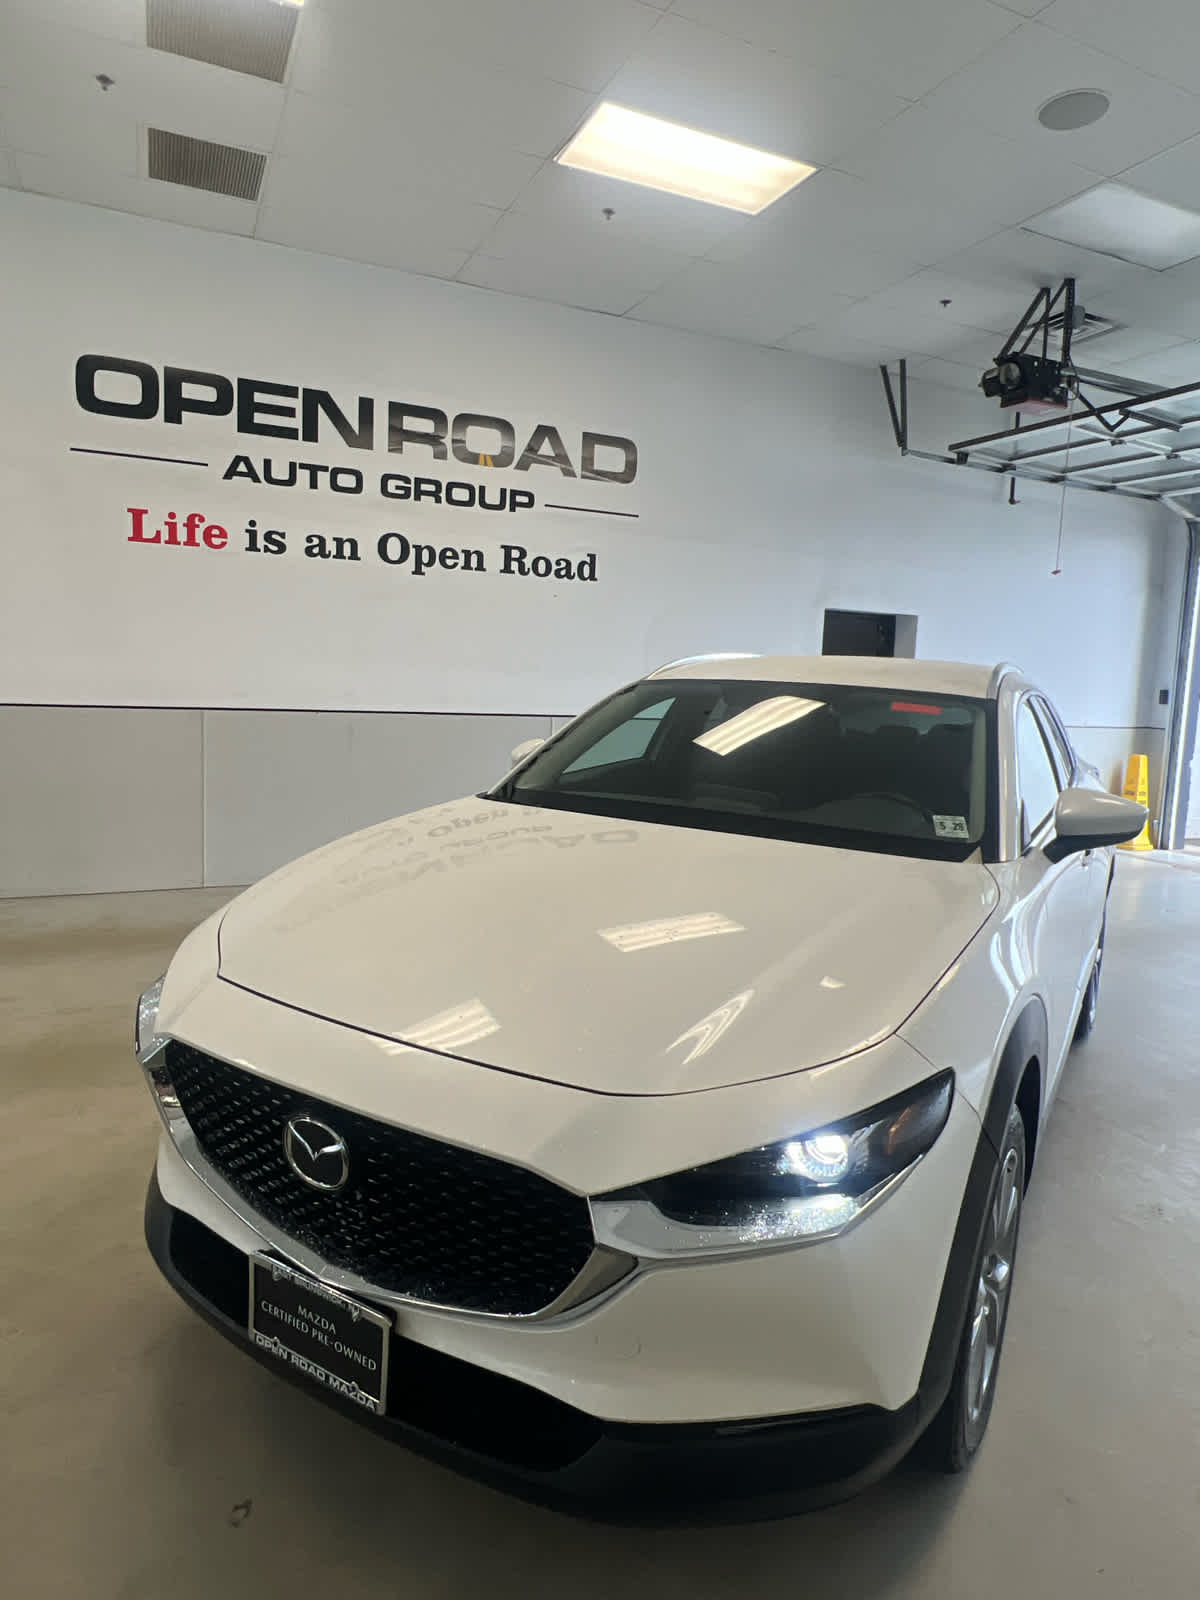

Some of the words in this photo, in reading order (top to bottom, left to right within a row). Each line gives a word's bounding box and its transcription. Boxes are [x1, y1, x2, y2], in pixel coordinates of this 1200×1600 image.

[222, 455, 363, 494] AUTO
[380, 473, 535, 512] GROUP
[127, 508, 228, 550] Life
[245, 520, 286, 555] is
[304, 534, 361, 561] an
[377, 532, 486, 575] Open
[500, 545, 598, 581] Road
[261, 1300, 309, 1334] CERTIFIED
[312, 1327, 377, 1371] PRE-OWNED
[298, 1304, 336, 1335] MAZDA
[256, 1335, 288, 1360] OPEN
[291, 1354, 326, 1381] ROAD
[329, 1377, 376, 1411] MAZDA
